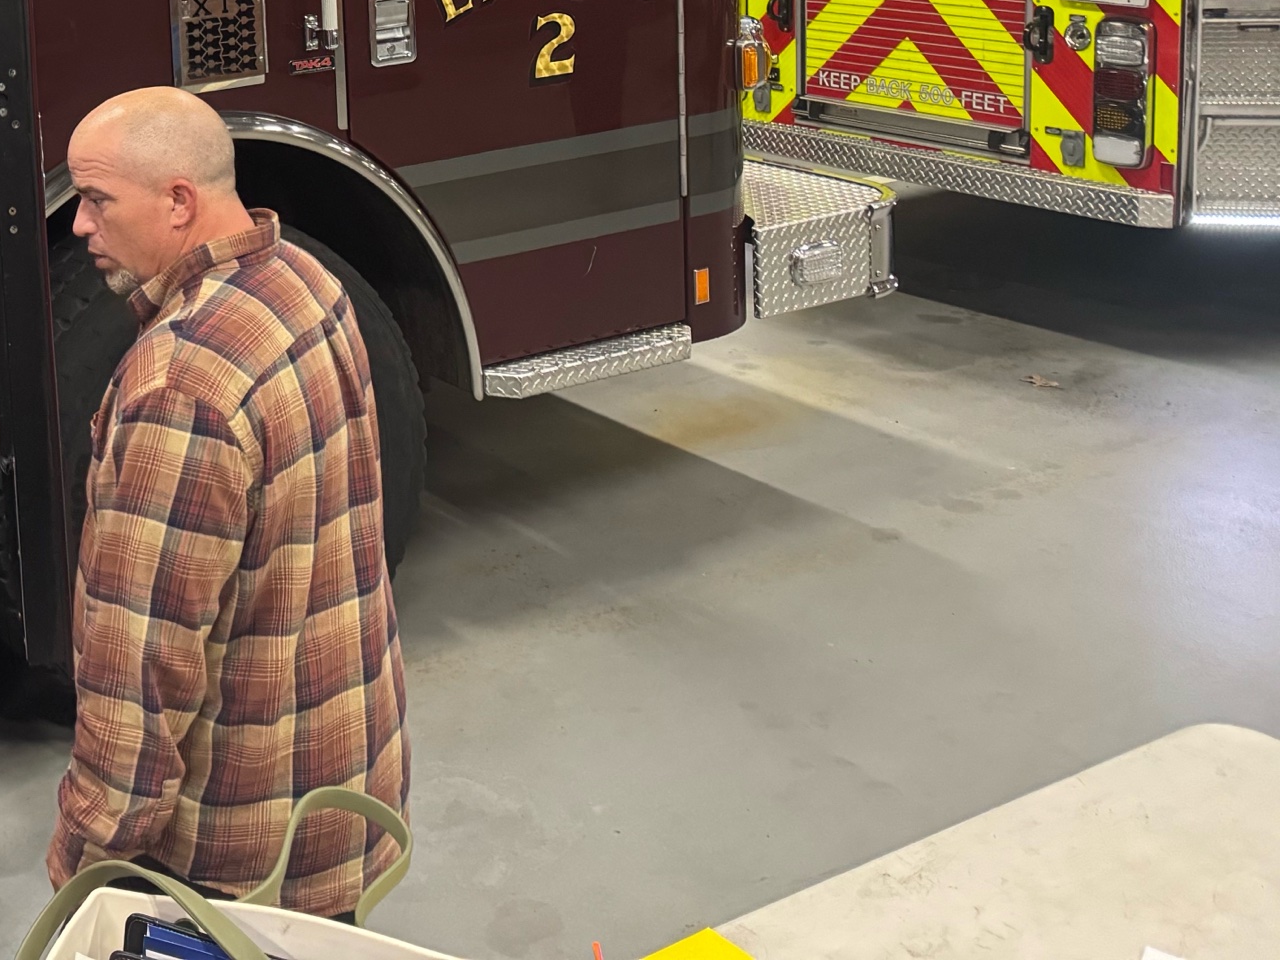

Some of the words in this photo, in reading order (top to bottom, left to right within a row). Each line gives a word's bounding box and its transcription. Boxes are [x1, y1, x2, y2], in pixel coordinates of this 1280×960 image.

[534, 12, 576, 79] 2
[818, 70, 861, 91] KEEP
[866, 77, 913, 100] BACK
[919, 84, 955, 106] 500
[960, 90, 1009, 114] FEET
